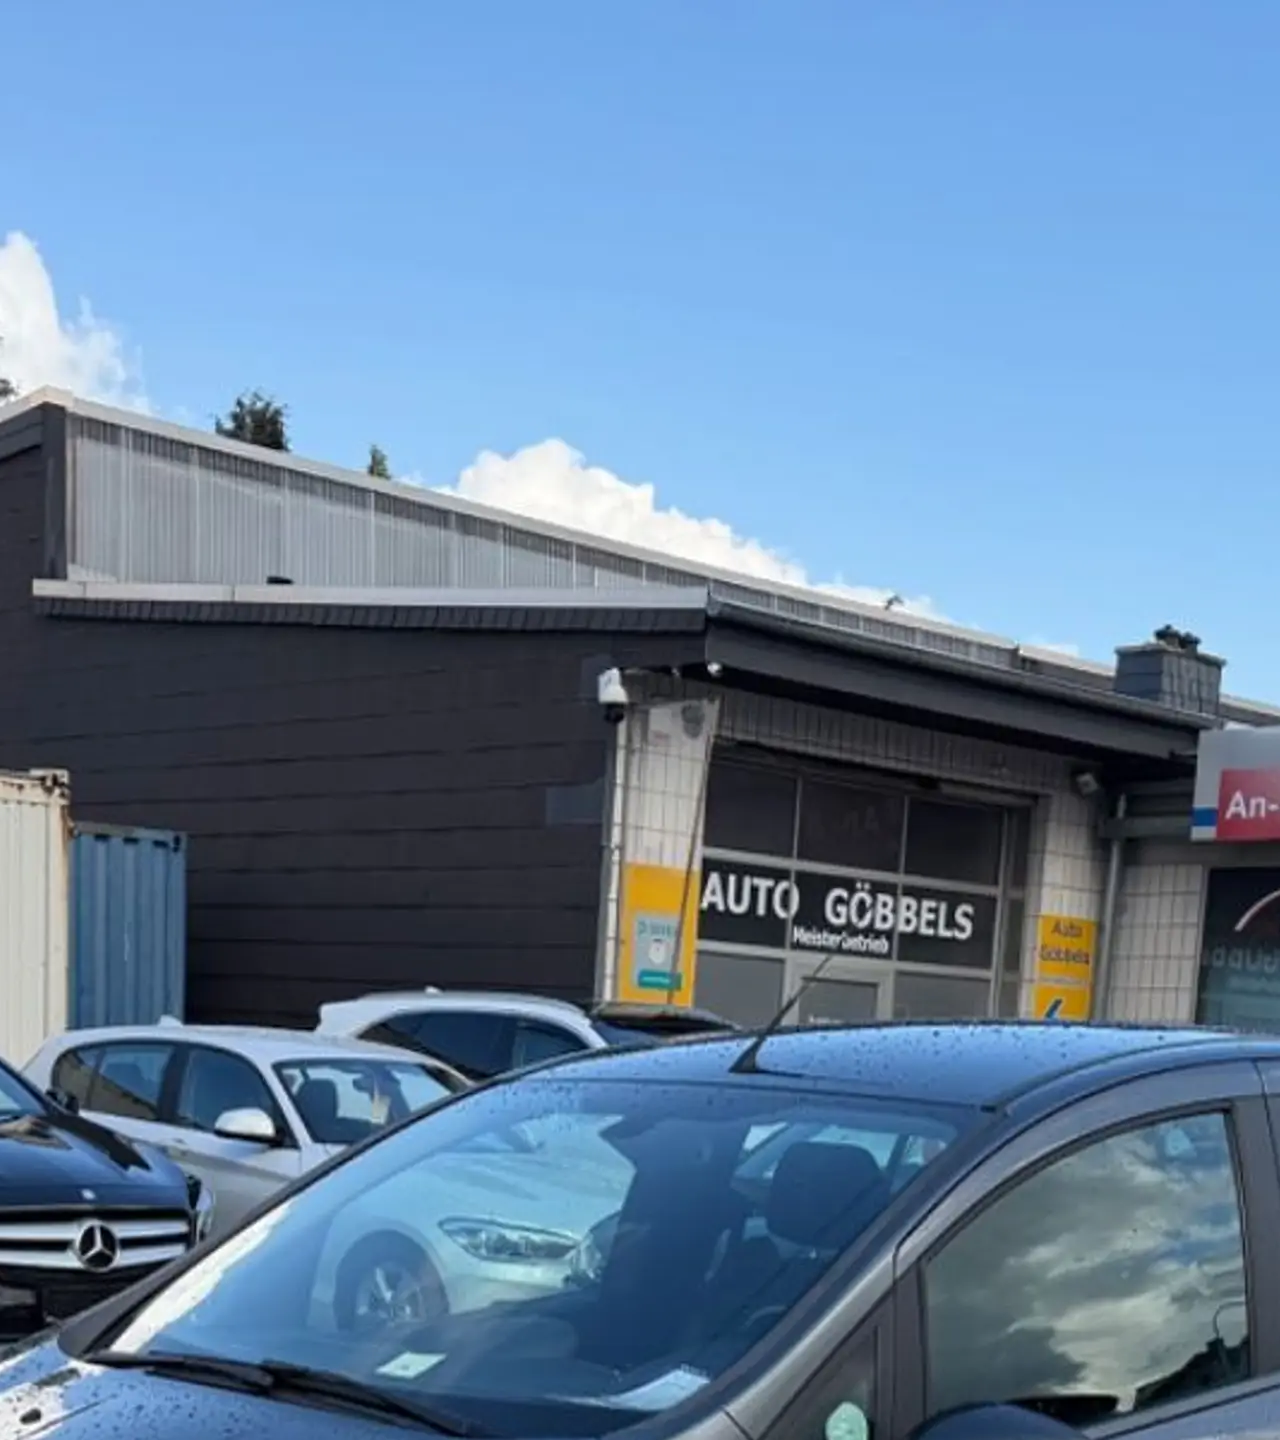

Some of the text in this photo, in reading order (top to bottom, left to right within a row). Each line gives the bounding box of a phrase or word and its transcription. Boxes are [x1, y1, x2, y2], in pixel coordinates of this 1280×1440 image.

[1225, 791, 1278, 821] An-
[700, 872, 975, 940] AUTO GÖBBELS
[1051, 919, 1083, 938] Auto
